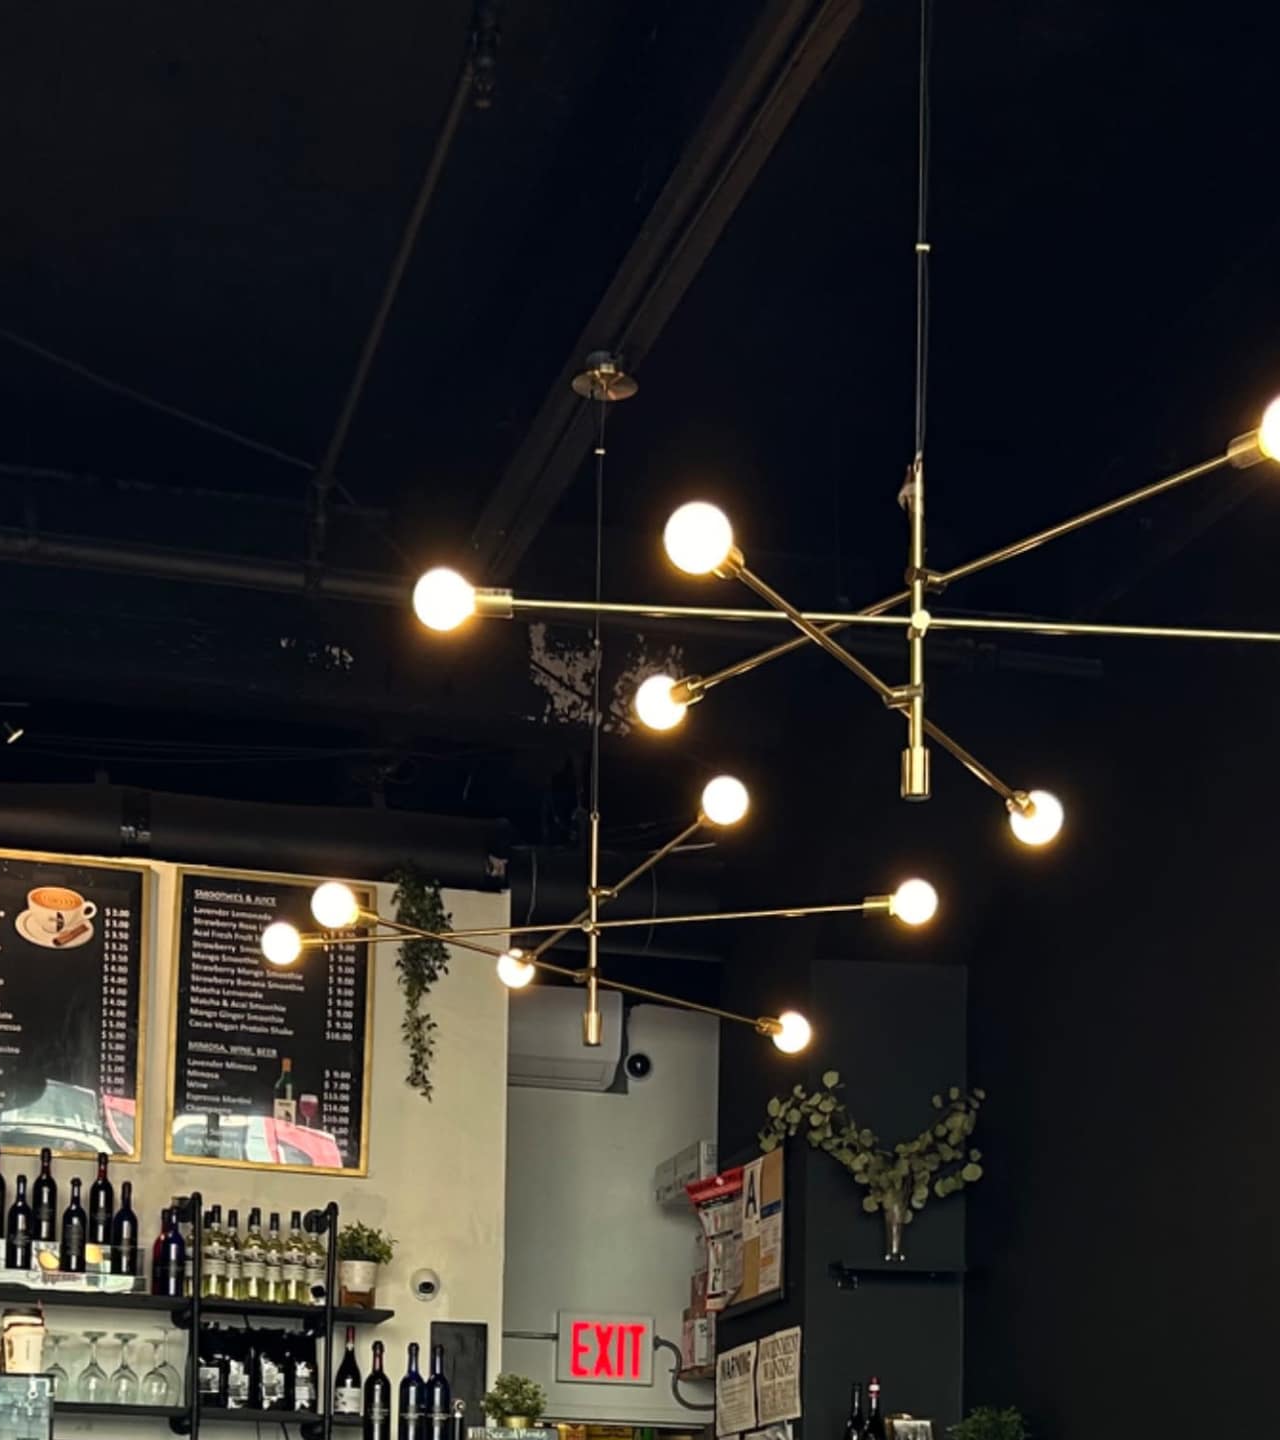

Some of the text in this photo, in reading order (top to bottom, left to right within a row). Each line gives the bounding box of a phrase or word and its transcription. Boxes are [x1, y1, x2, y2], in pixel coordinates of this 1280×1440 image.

[193, 905, 273, 921] Lavender Lemonade
[192, 917, 237, 930] Strawberry
[191, 951, 220, 964] Mango
[220, 953, 260, 966] Smoothie
[191, 962, 235, 975] Strawberry
[236, 966, 265, 979] Mango
[265, 969, 304, 981] Smoothie
[190, 973, 235, 987] Strawberry
[236, 977, 266, 989] Banana
[267, 980, 305, 992] Smoothie
[190, 984, 221, 995] Matcha
[221, 987, 264, 999] Lemonade
[189, 996, 220, 1007] Matcha
[249, 1001, 287, 1013] Smoothie
[188, 1007, 285, 1024] Mango Ginger Smoothie
[187, 1018, 295, 1036] Cacao Vegan Protein Shake
[256, 1047, 278, 1058] BEER
[186, 1057, 224, 1070] Lavender
[224, 1059, 259, 1072] Mimosa
[186, 1068, 220, 1080] Mimosa
[185, 1079, 209, 1090] Wine
[185, 1092, 221, 1104] Espresso
[222, 1095, 252, 1105] Martini
[744, 1170, 758, 1221] A
[569, 1321, 646, 1379] EXIT
